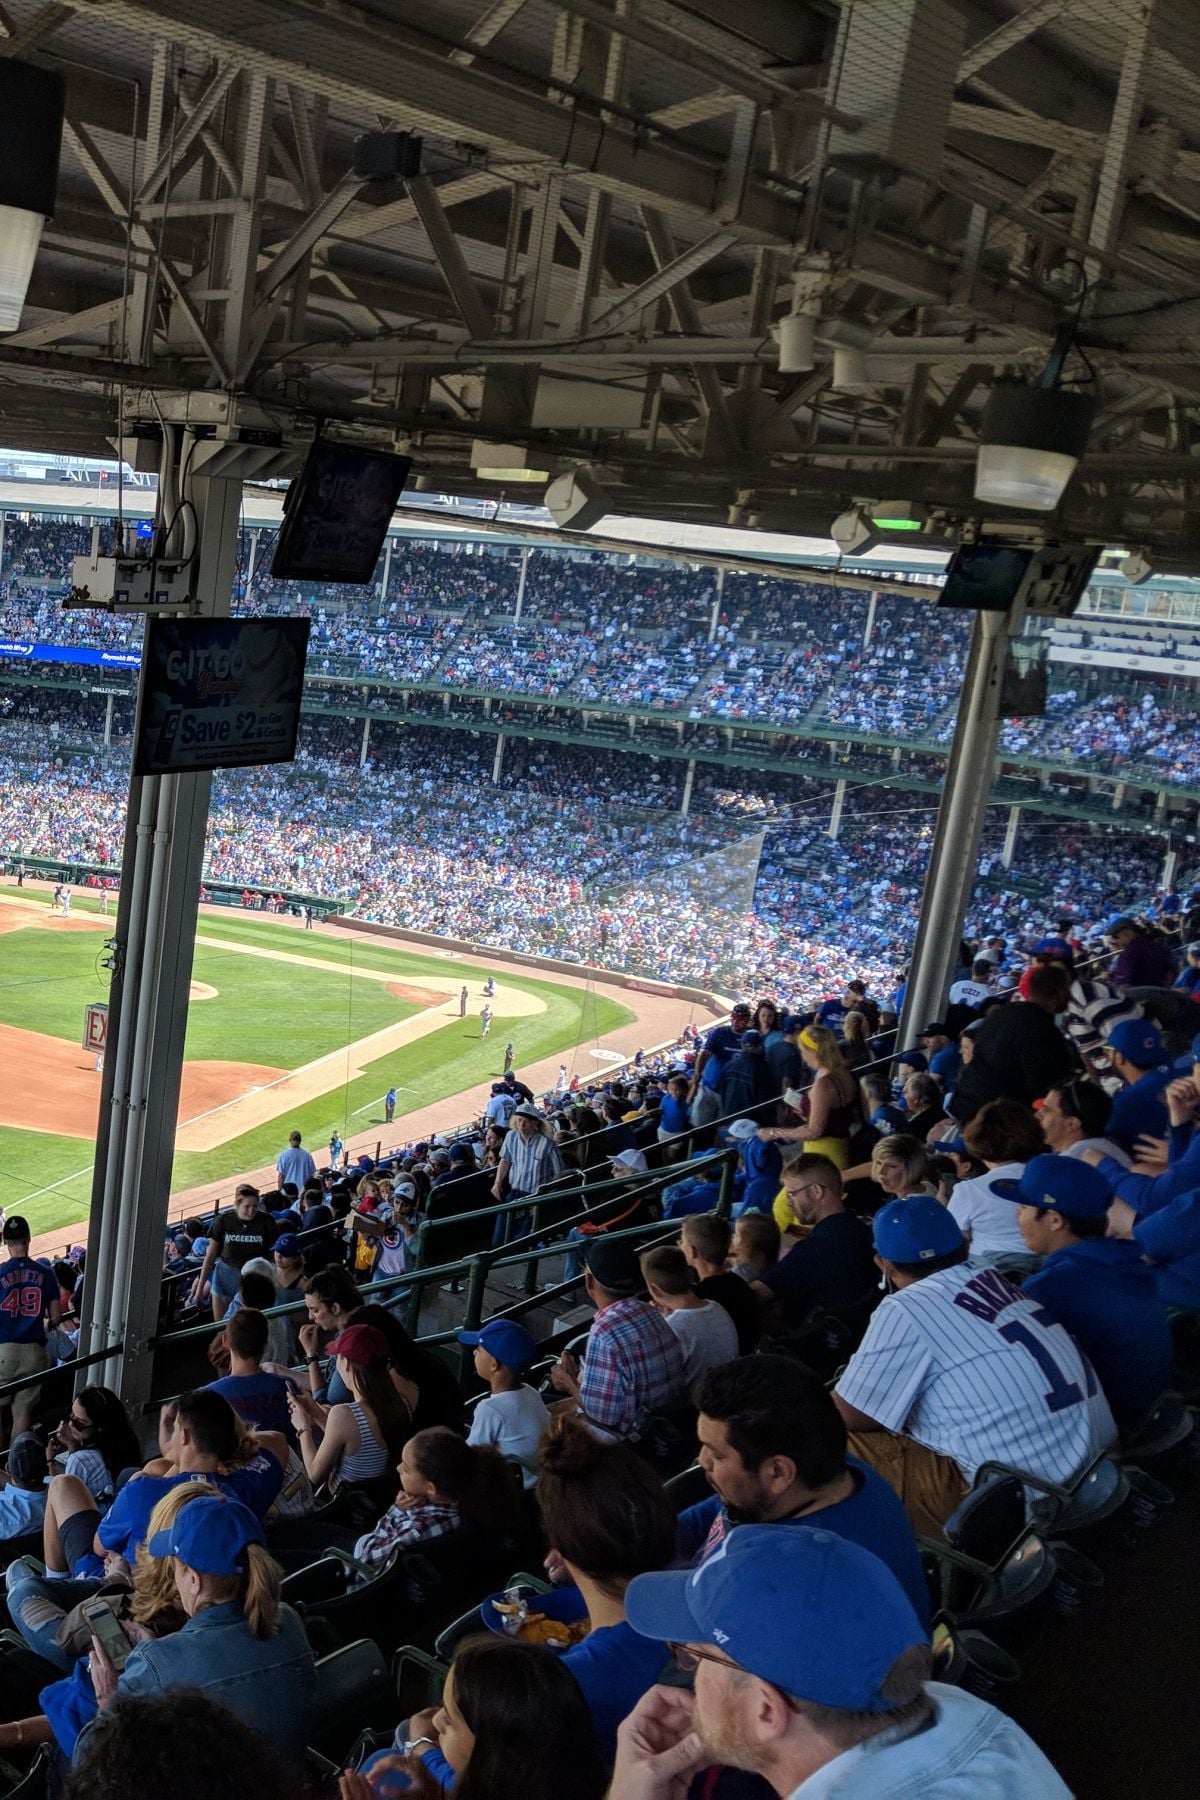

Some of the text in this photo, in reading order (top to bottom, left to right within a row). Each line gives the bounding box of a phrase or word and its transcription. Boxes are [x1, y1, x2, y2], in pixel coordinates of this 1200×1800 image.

[180, 712, 257, 744] Save $2
[0, 1286, 42, 1318] 49
